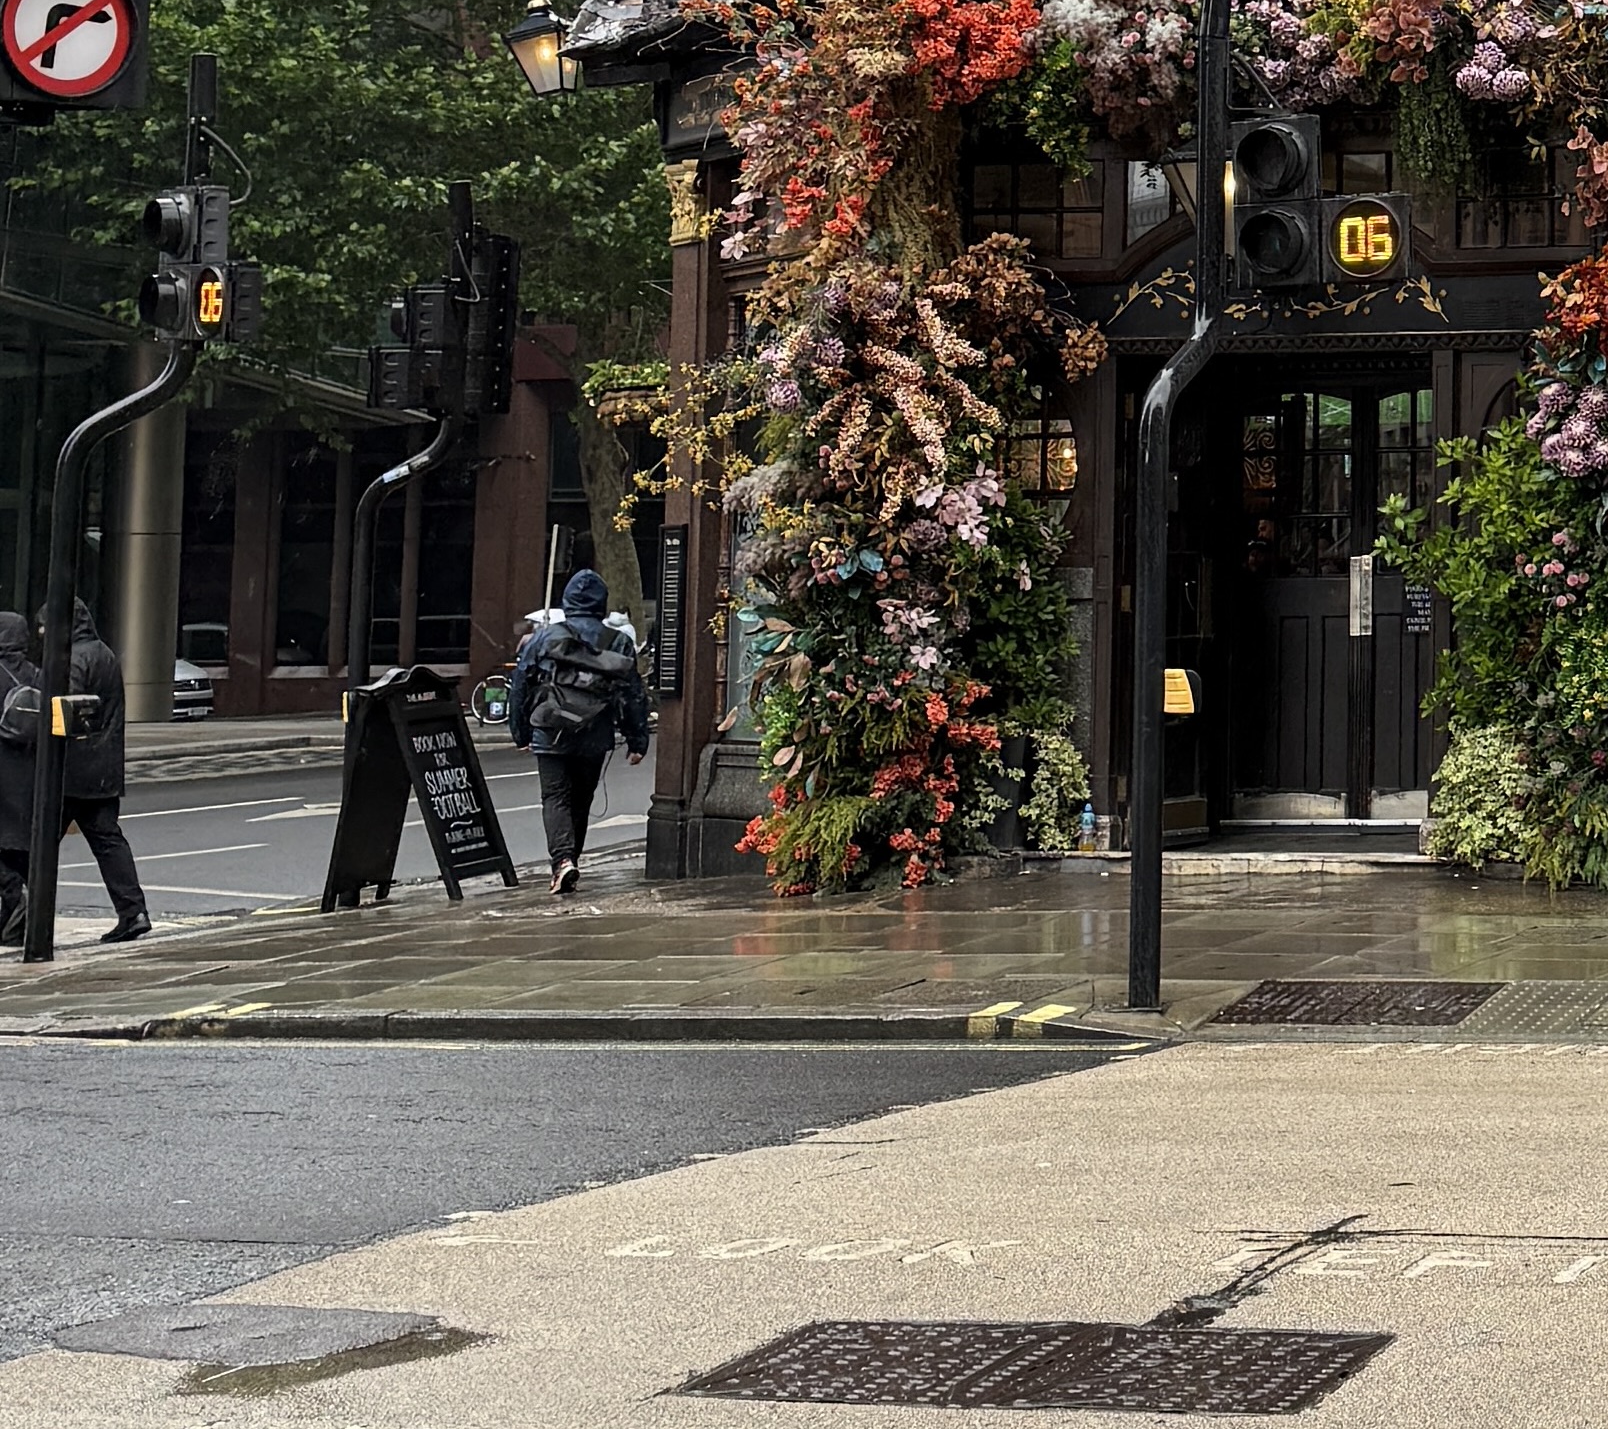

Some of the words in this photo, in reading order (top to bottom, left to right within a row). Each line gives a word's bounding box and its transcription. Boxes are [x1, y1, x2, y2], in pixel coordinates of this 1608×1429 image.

[1340, 214, 1393, 262] 06
[199, 281, 224, 323] 06
[424, 766, 473, 795] SUMMER
[603, 1234, 1024, 1266] LOOK
